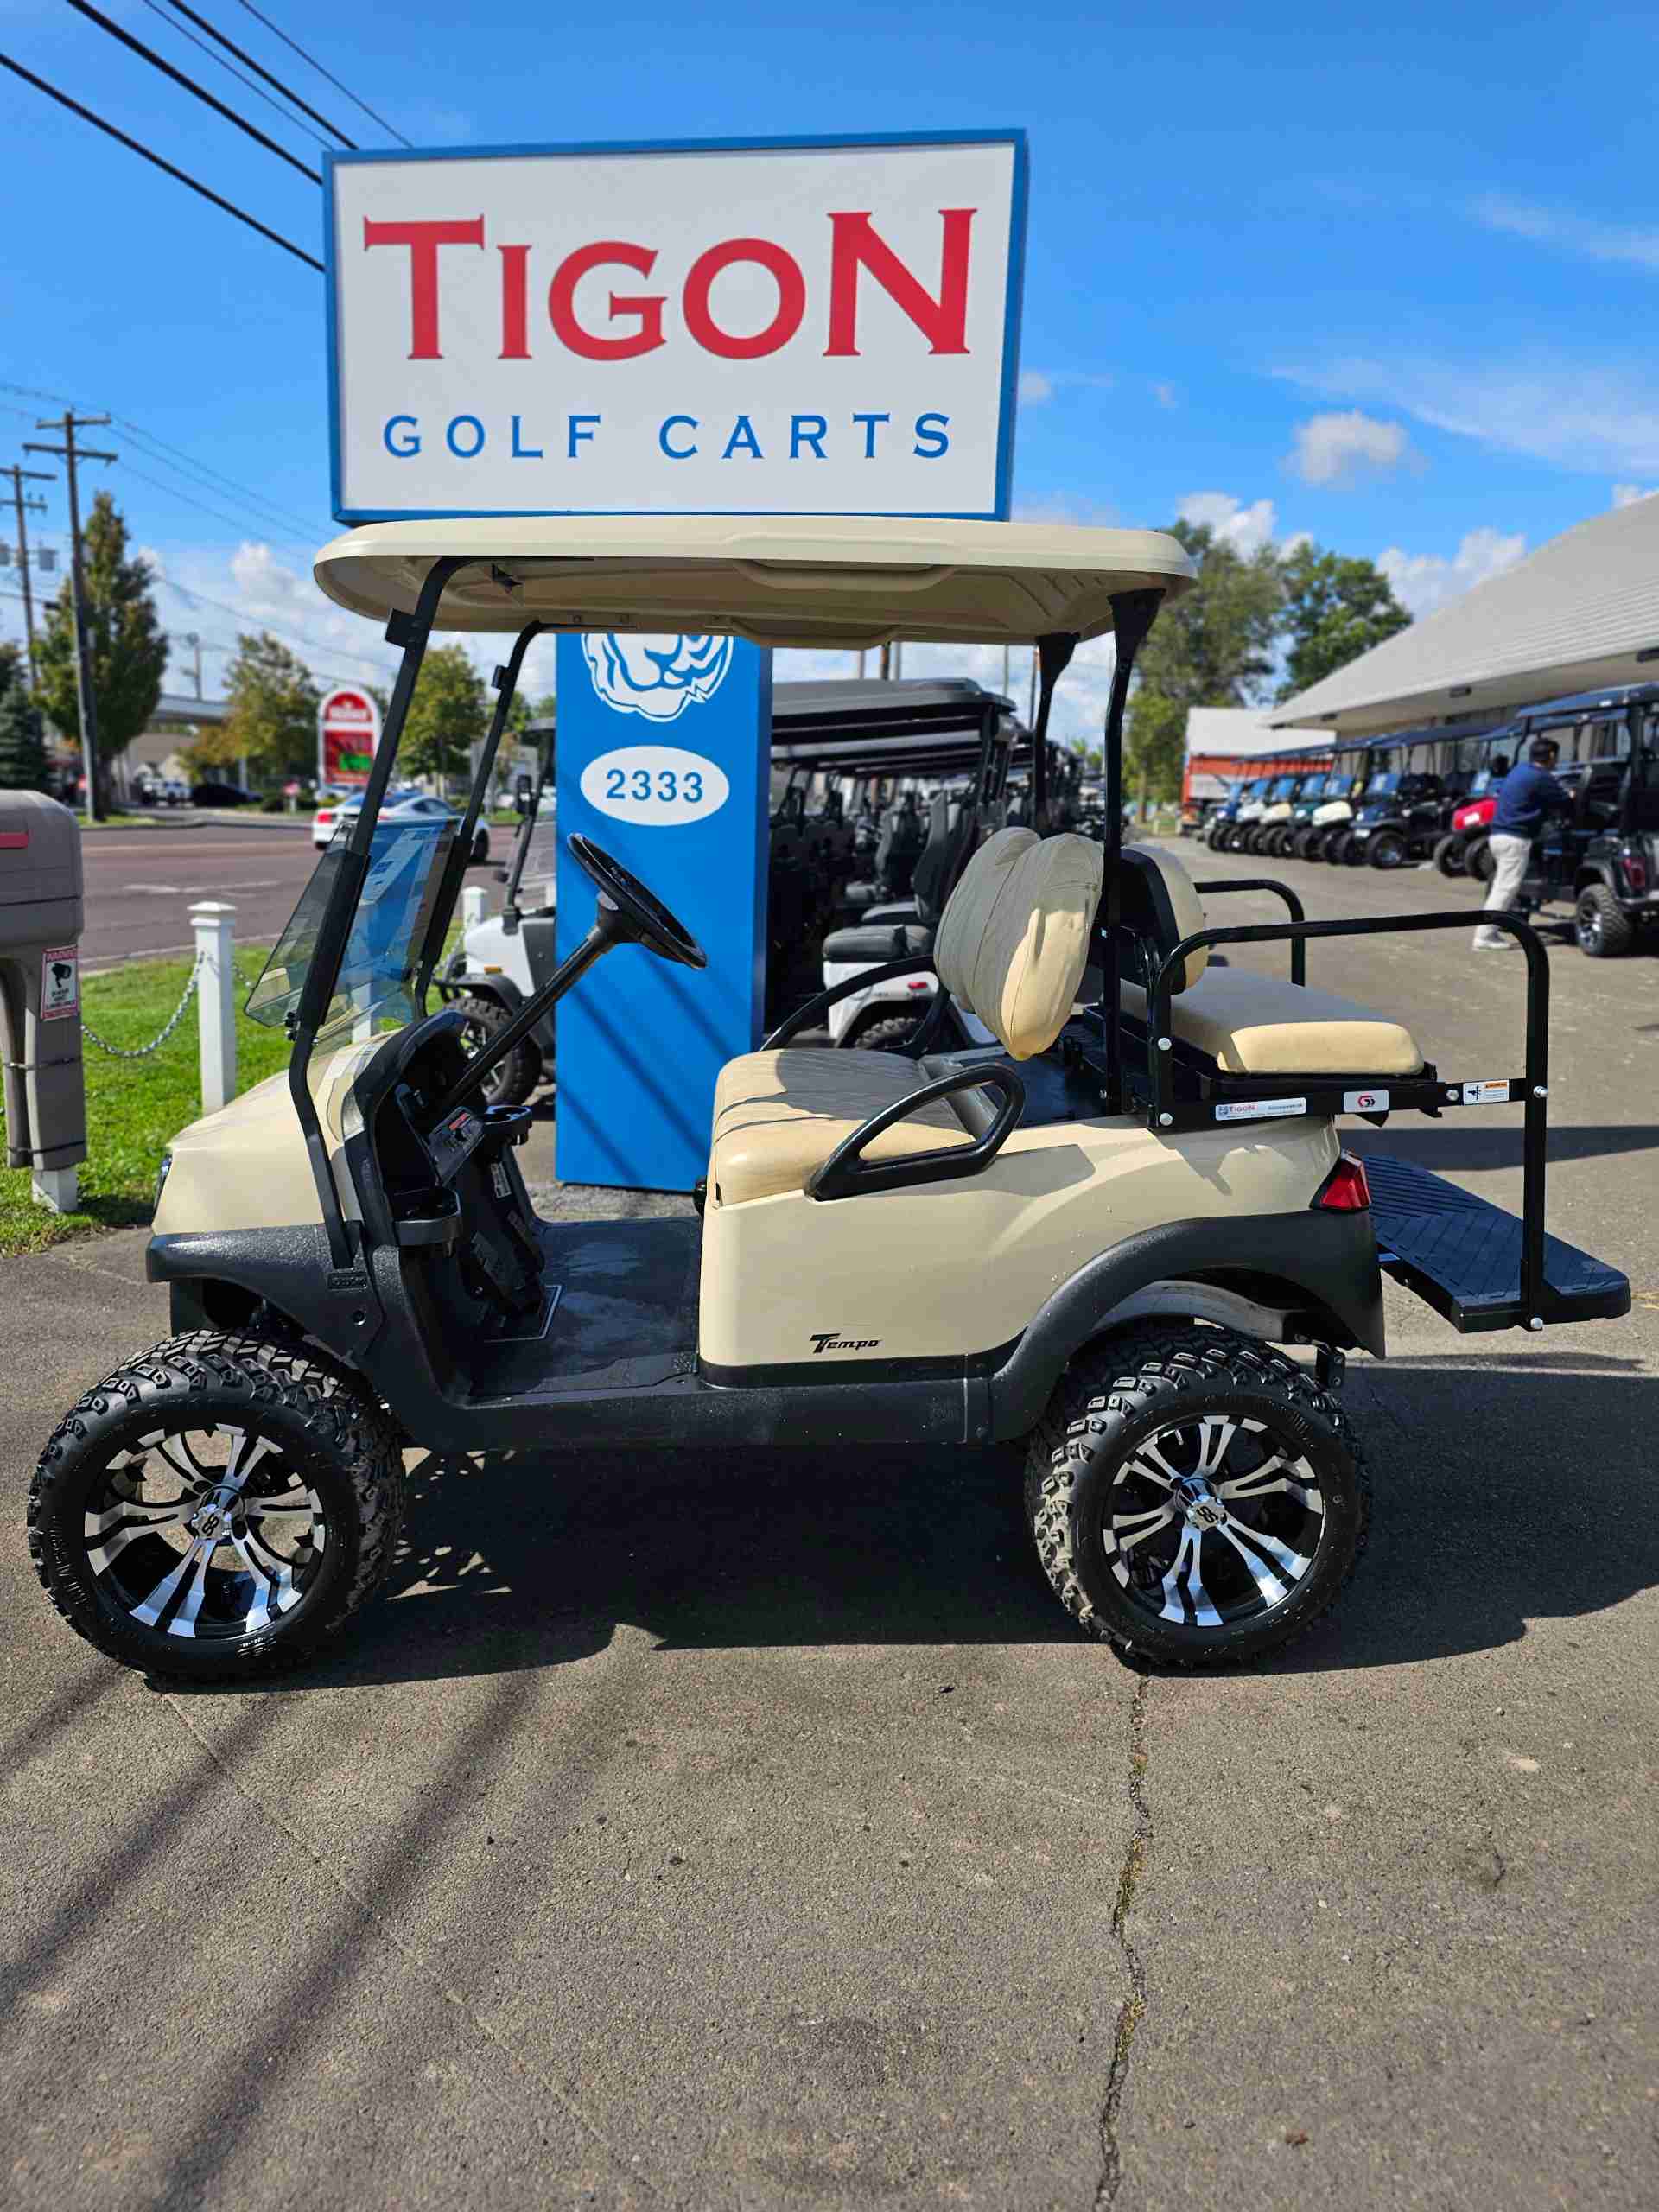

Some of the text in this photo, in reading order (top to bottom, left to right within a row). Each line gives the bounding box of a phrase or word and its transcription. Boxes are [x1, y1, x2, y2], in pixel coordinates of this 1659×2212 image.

[384, 412, 950, 459] GOLF CARTS
[606, 768, 702, 803] 2333
[810, 1332, 882, 1354] Tempo
